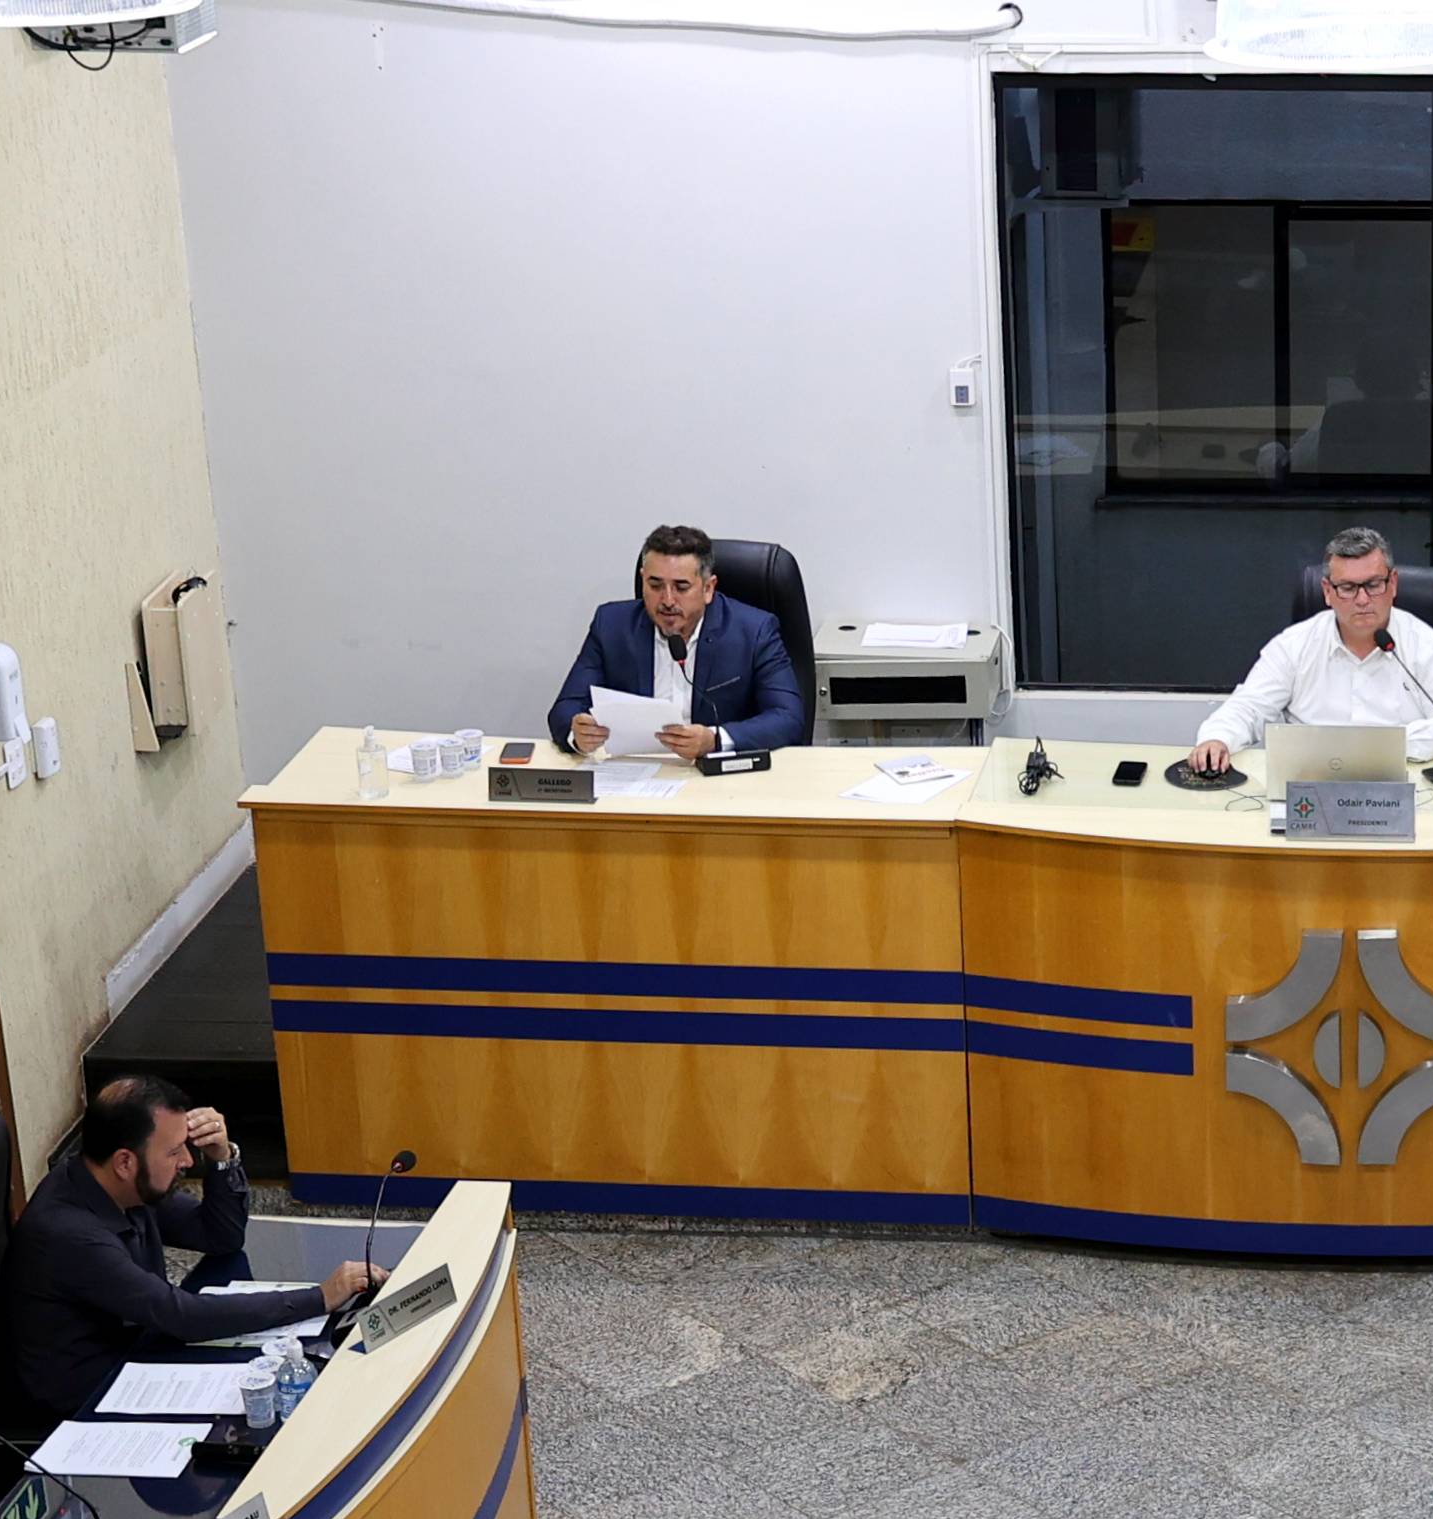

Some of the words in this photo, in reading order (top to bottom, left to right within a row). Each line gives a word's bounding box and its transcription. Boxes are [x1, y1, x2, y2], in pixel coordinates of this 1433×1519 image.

[1337, 798, 1362, 808] Odair
[1366, 798, 1400, 808] Paviani
[400, 1286, 433, 1309] FERNANDO
[432, 1278, 448, 1291] LIMA
